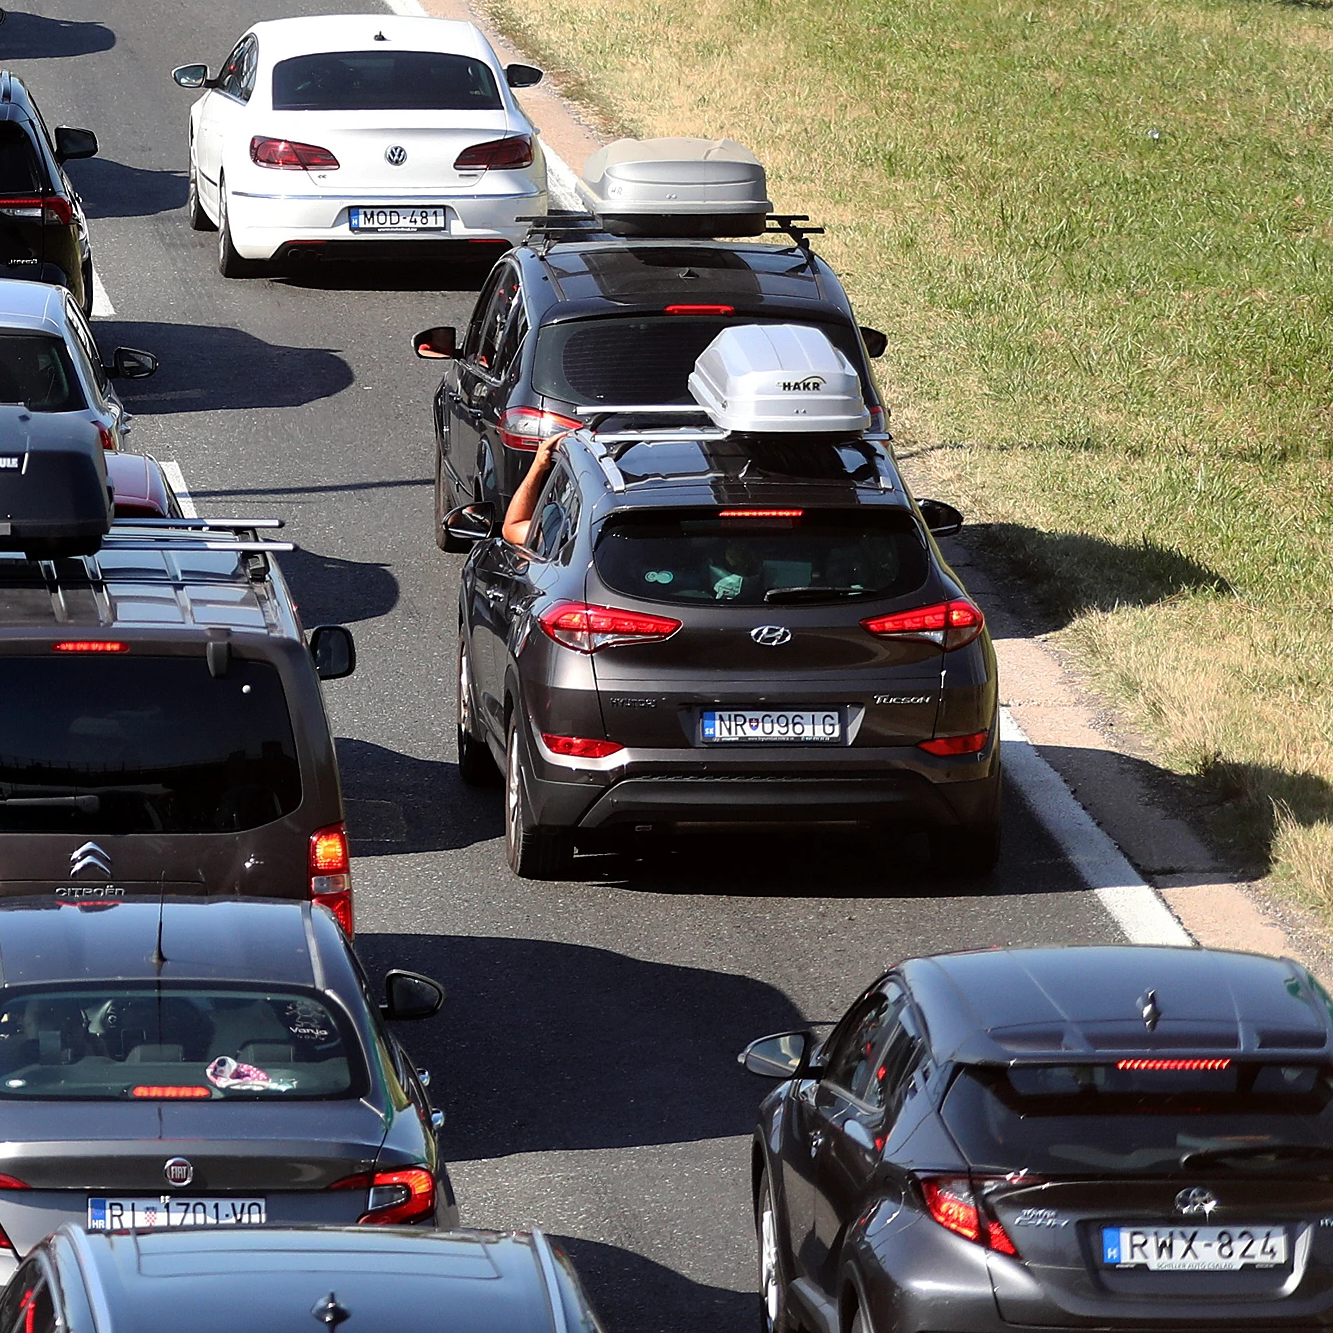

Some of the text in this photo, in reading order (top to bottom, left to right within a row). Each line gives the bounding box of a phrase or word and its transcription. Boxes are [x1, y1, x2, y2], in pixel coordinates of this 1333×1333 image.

[363, 210, 439, 226] MOD-481
[783, 381, 821, 392] HAKR
[704, 727, 715, 735] SK
[718, 714, 748, 735] NR
[55, 884, 126, 898] CITROËN
[170, 1166, 188, 1179] FIAT
[92, 1219, 105, 1228] HR
[109, 1203, 136, 1228] RI
[1107, 1229, 1277, 1260] H RWX-824
